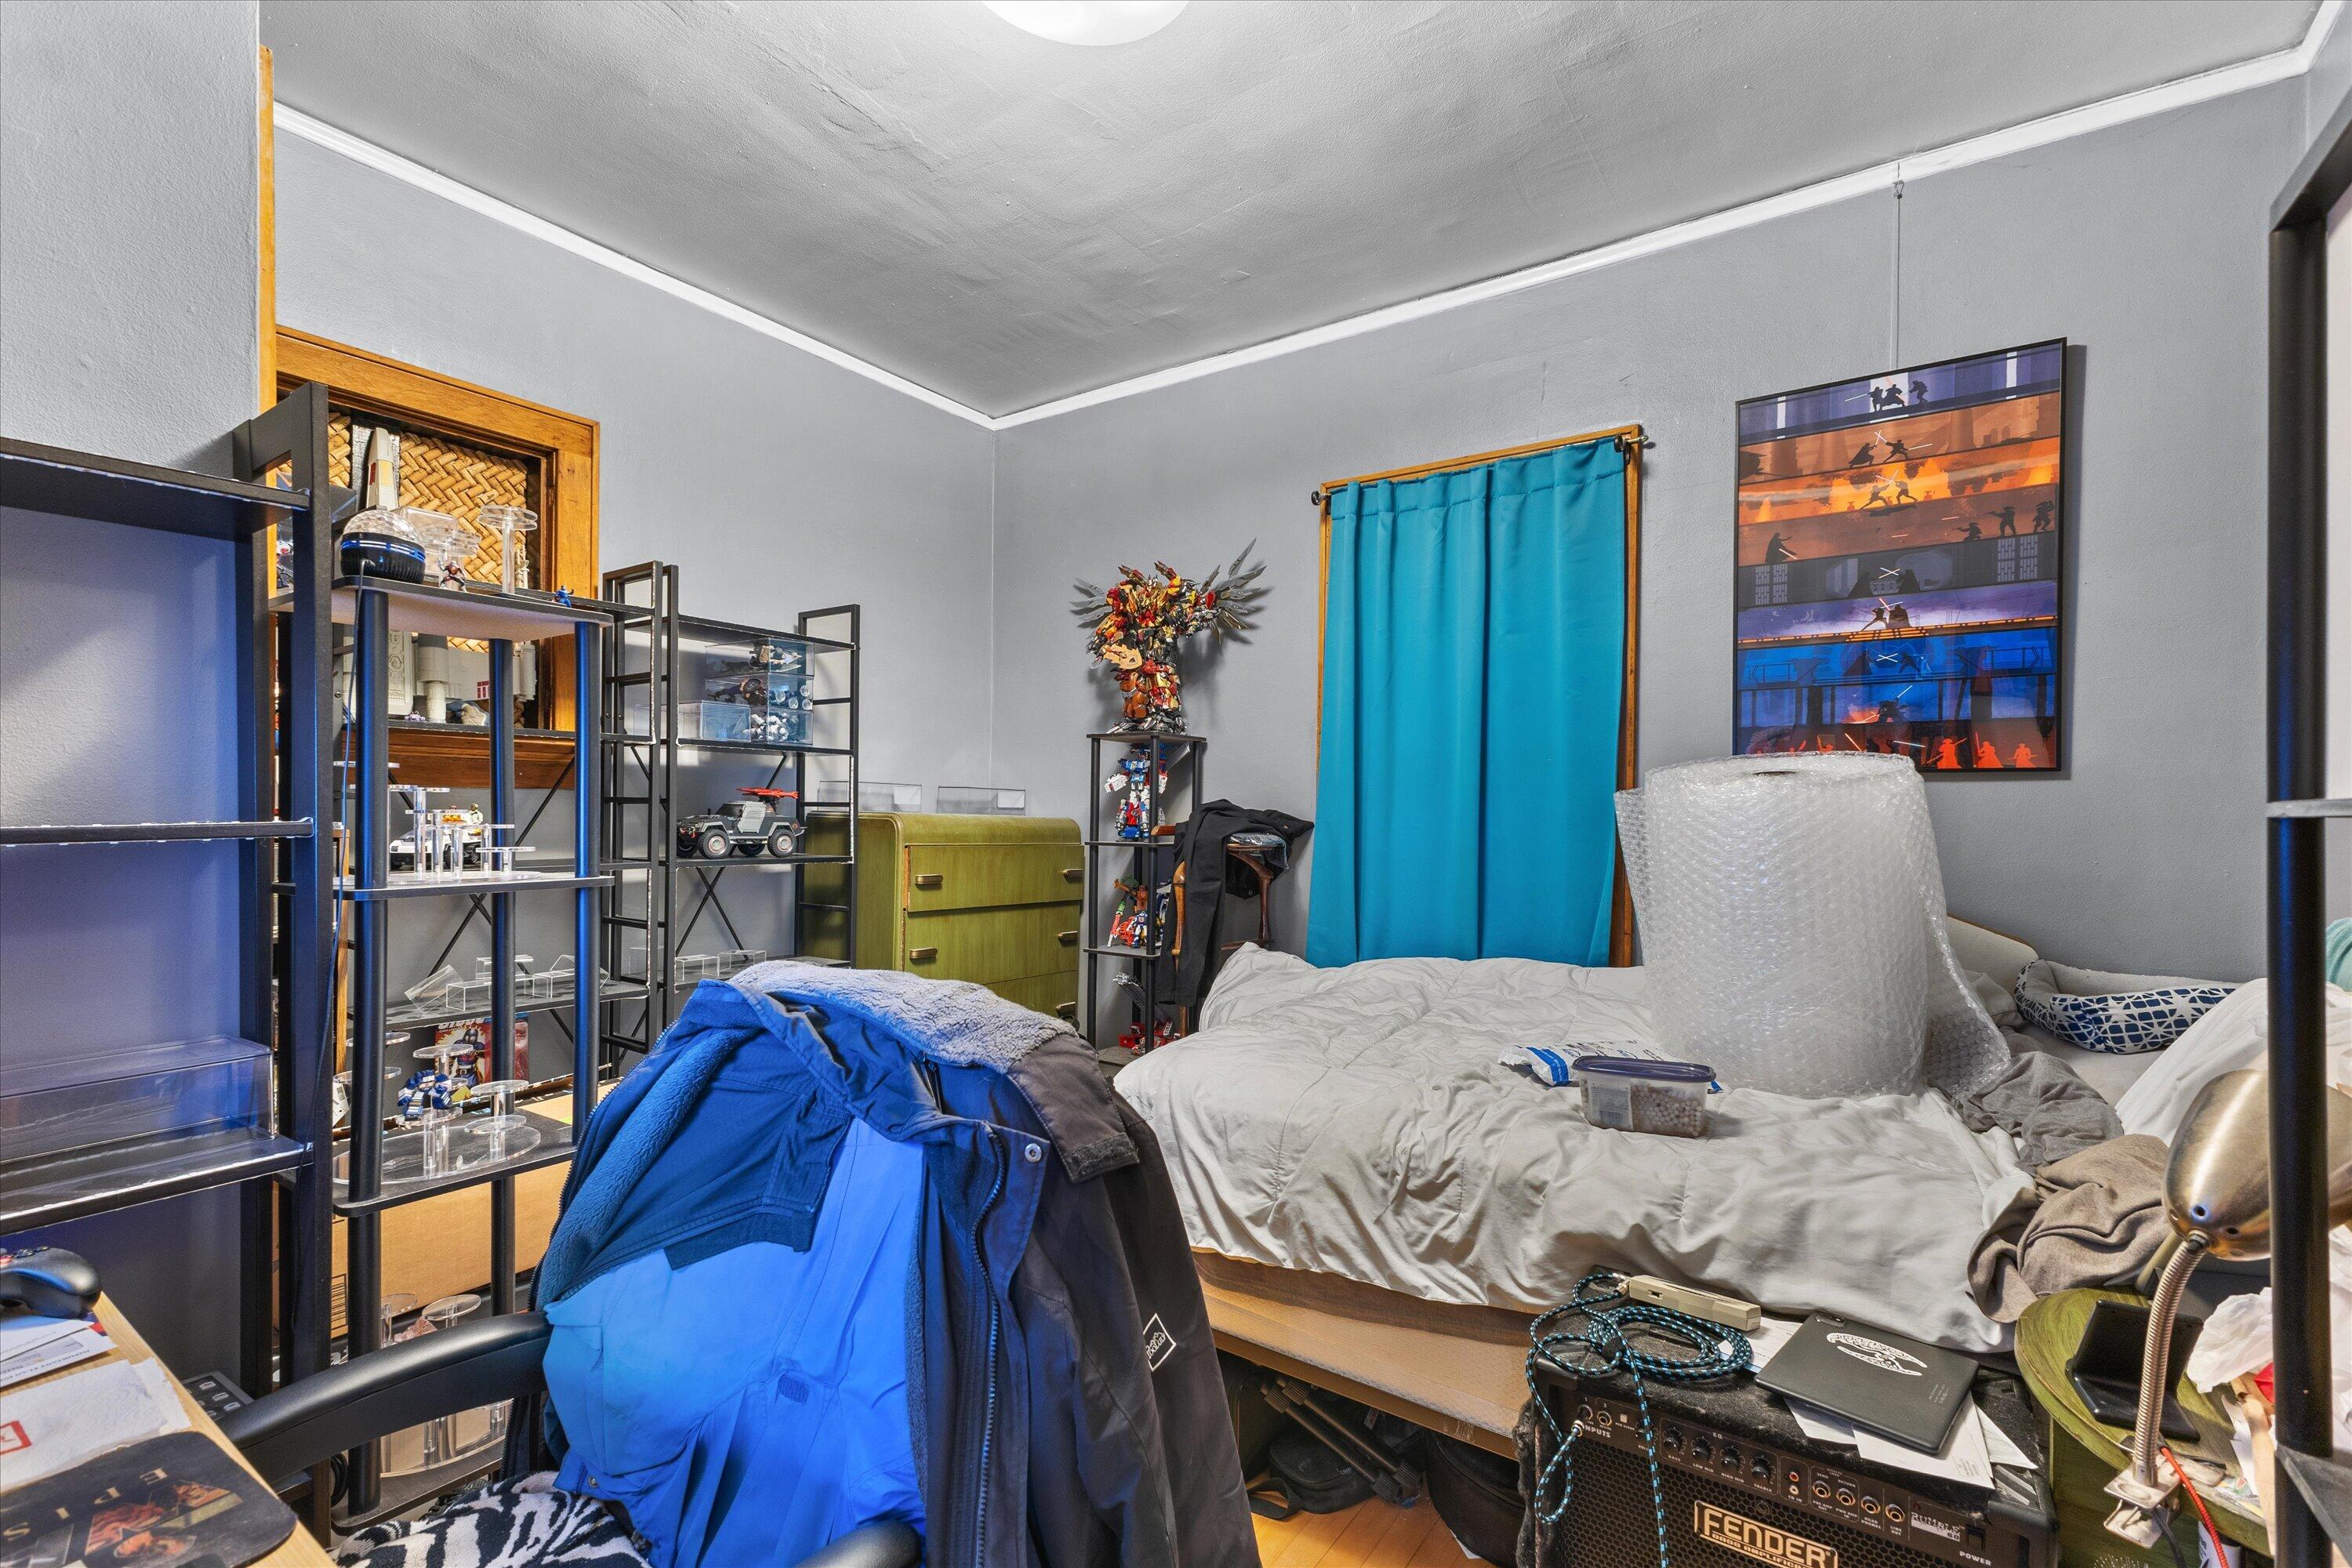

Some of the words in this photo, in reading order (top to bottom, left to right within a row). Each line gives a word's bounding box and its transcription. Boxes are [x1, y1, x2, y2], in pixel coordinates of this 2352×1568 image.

[1584, 1425, 1611, 1439] NPUTS
[1712, 1432, 1723, 1440] EQ
[1753, 1483, 1773, 1493] TREBLE
[1911, 1512, 1961, 1534] RUMBLE
[1959, 1550, 1992, 1566] POWER
